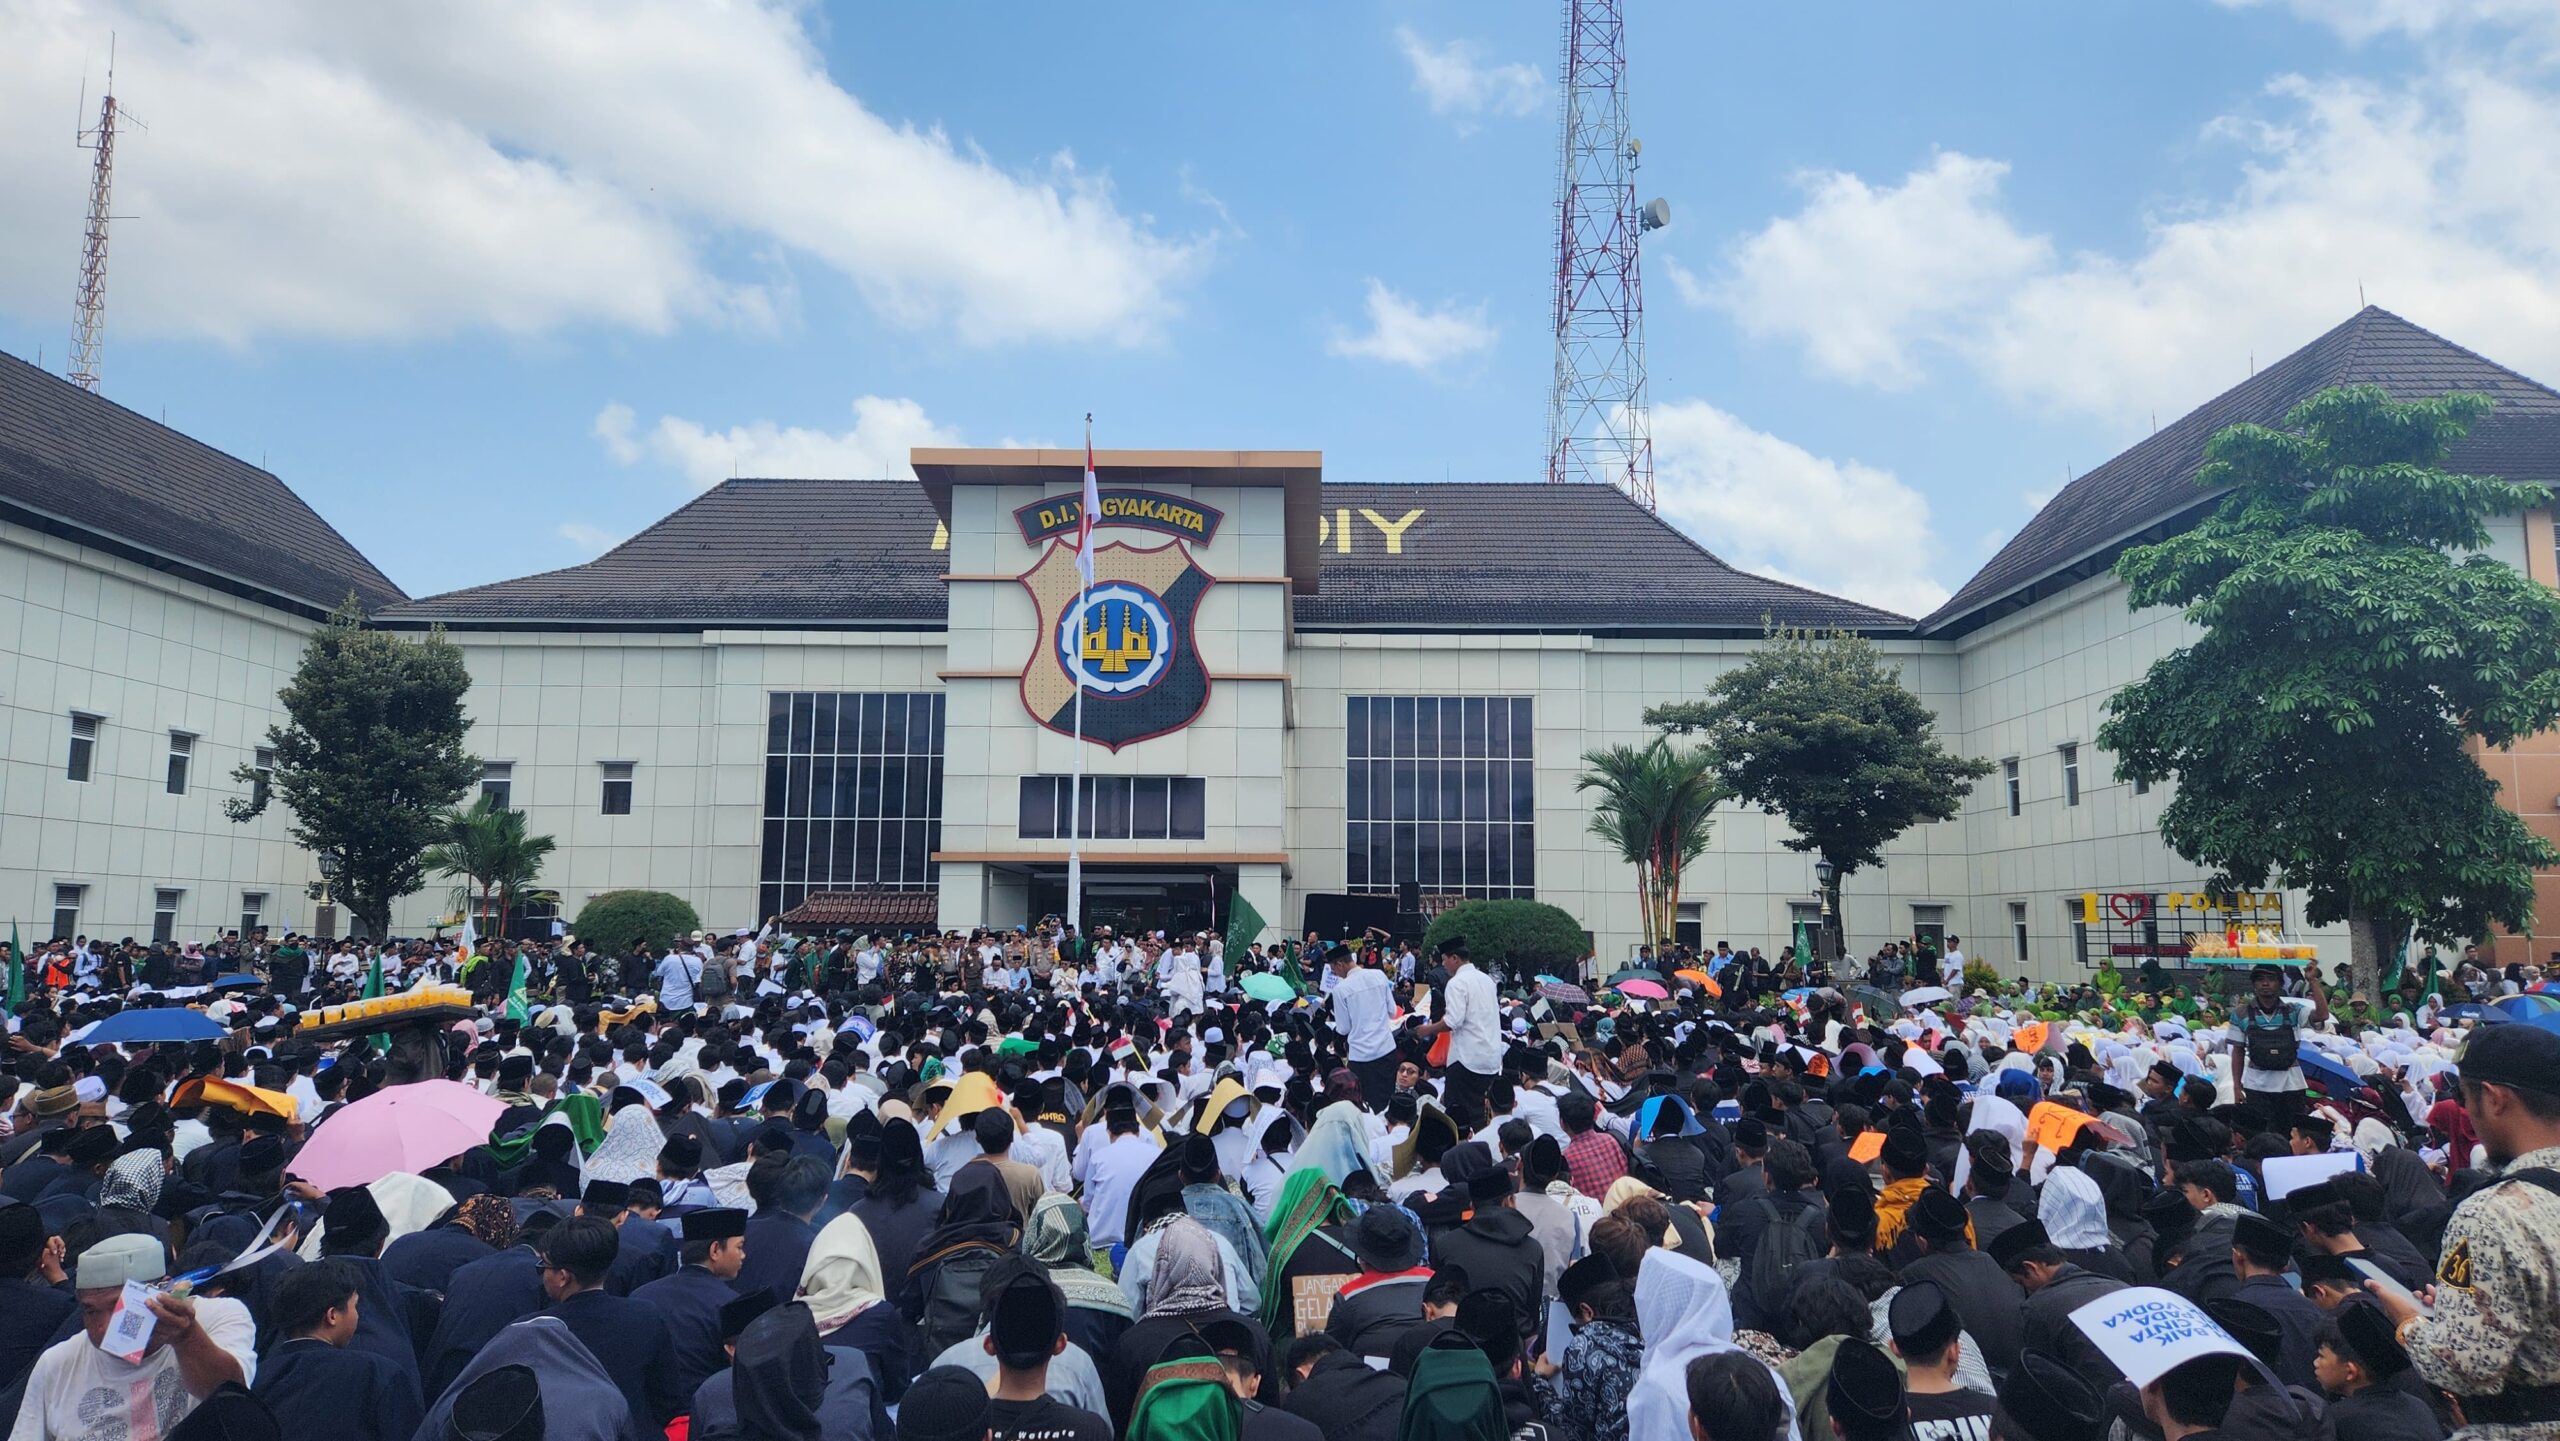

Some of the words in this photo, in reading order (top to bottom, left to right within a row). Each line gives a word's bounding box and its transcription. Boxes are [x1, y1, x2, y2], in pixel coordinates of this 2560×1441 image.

[2080, 893, 2100, 924] I
[2167, 891, 2281, 913] POLDA
[2448, 1255, 2471, 1283] 36
[2102, 1301, 2181, 1329] VODKA
[2128, 1318, 2192, 1344] CINTA
[2155, 1327, 2209, 1347] BAIK
